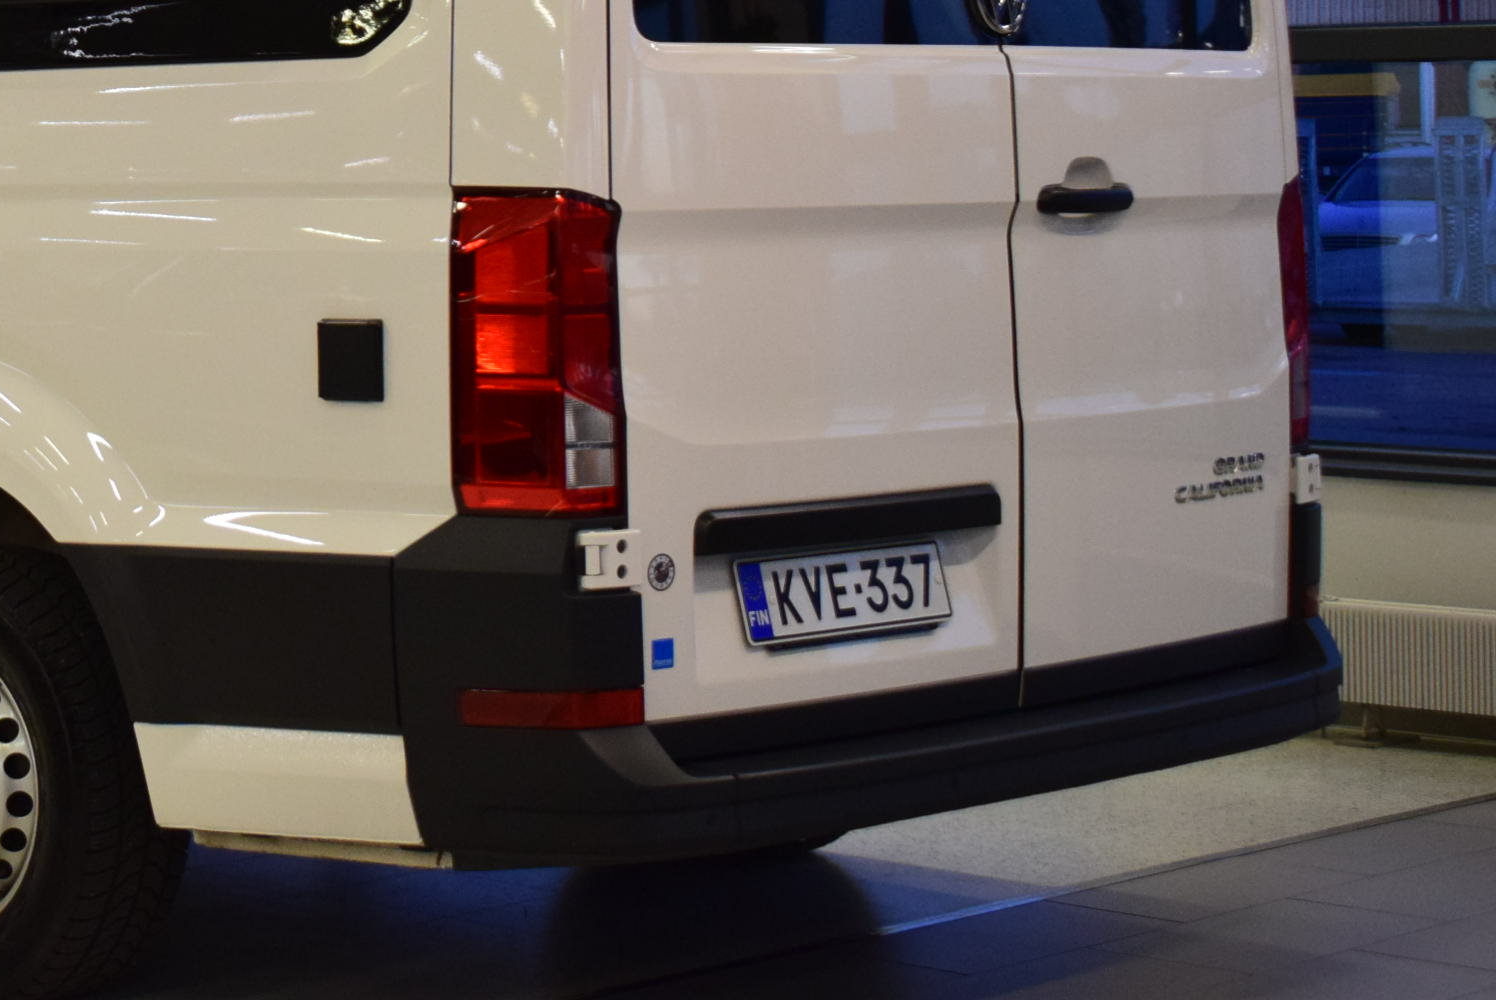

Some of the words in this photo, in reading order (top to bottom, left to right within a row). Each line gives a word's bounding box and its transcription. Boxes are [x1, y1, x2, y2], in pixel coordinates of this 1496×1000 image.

[1212, 452, 1265, 476] GRAND
[1174, 475, 1263, 504] CALIFORNIA
[748, 609, 770, 627] FIN
